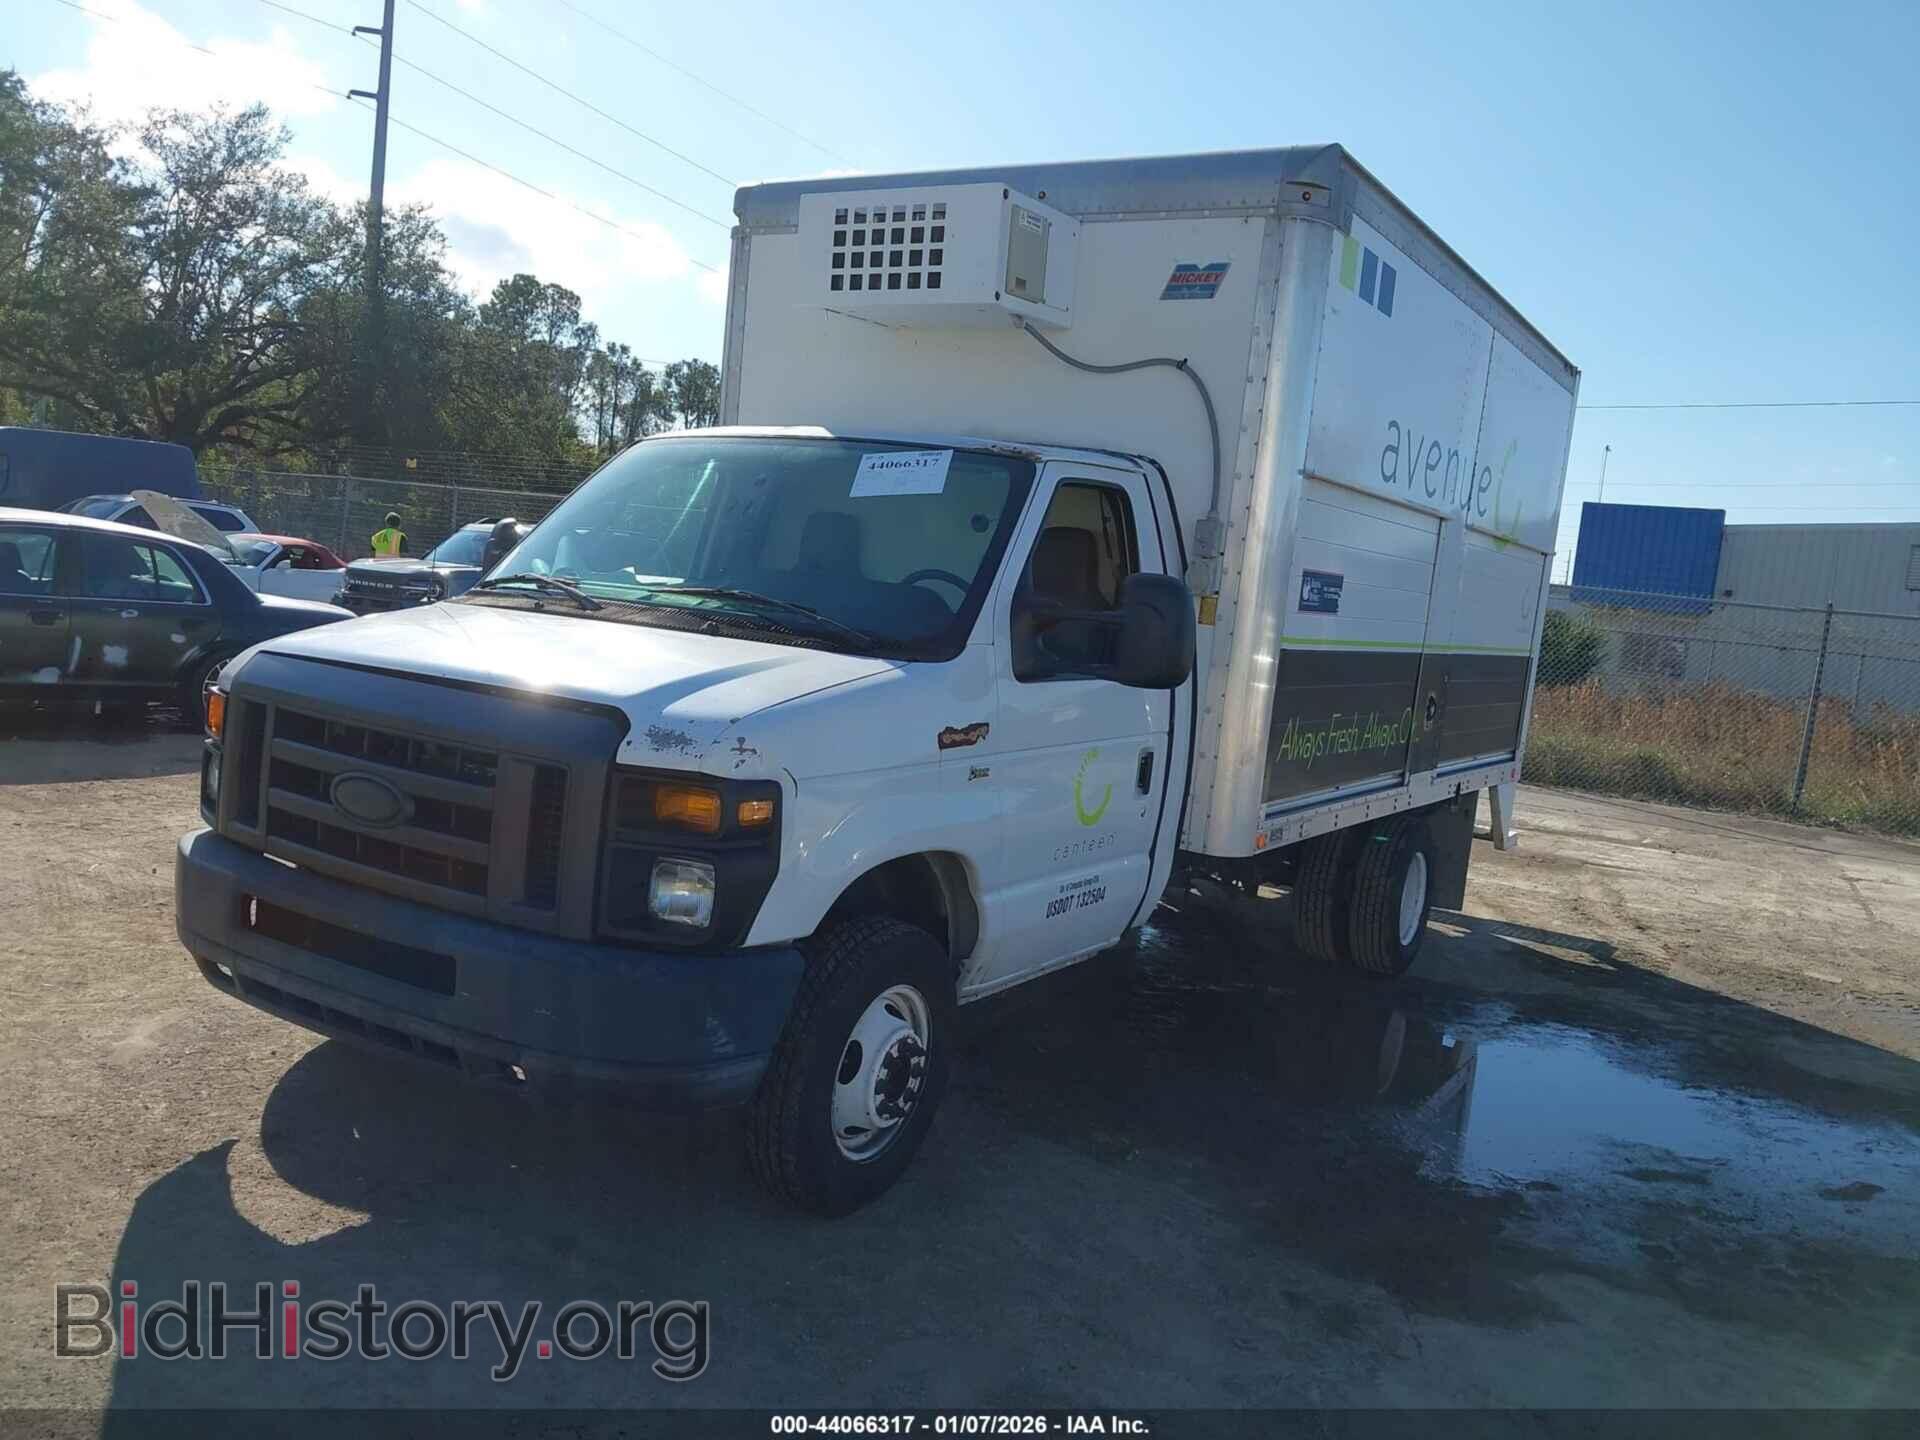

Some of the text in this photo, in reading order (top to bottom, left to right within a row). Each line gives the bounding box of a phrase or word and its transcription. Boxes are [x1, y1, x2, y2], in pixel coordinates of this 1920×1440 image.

[867, 459, 940, 470] 44066317
[1381, 419, 1492, 517] avenue
[1275, 715, 1326, 769] Always
[1360, 711, 1399, 755] Always
[1054, 833, 1114, 861] canteen
[1046, 886, 1106, 918] USDOT 132504
